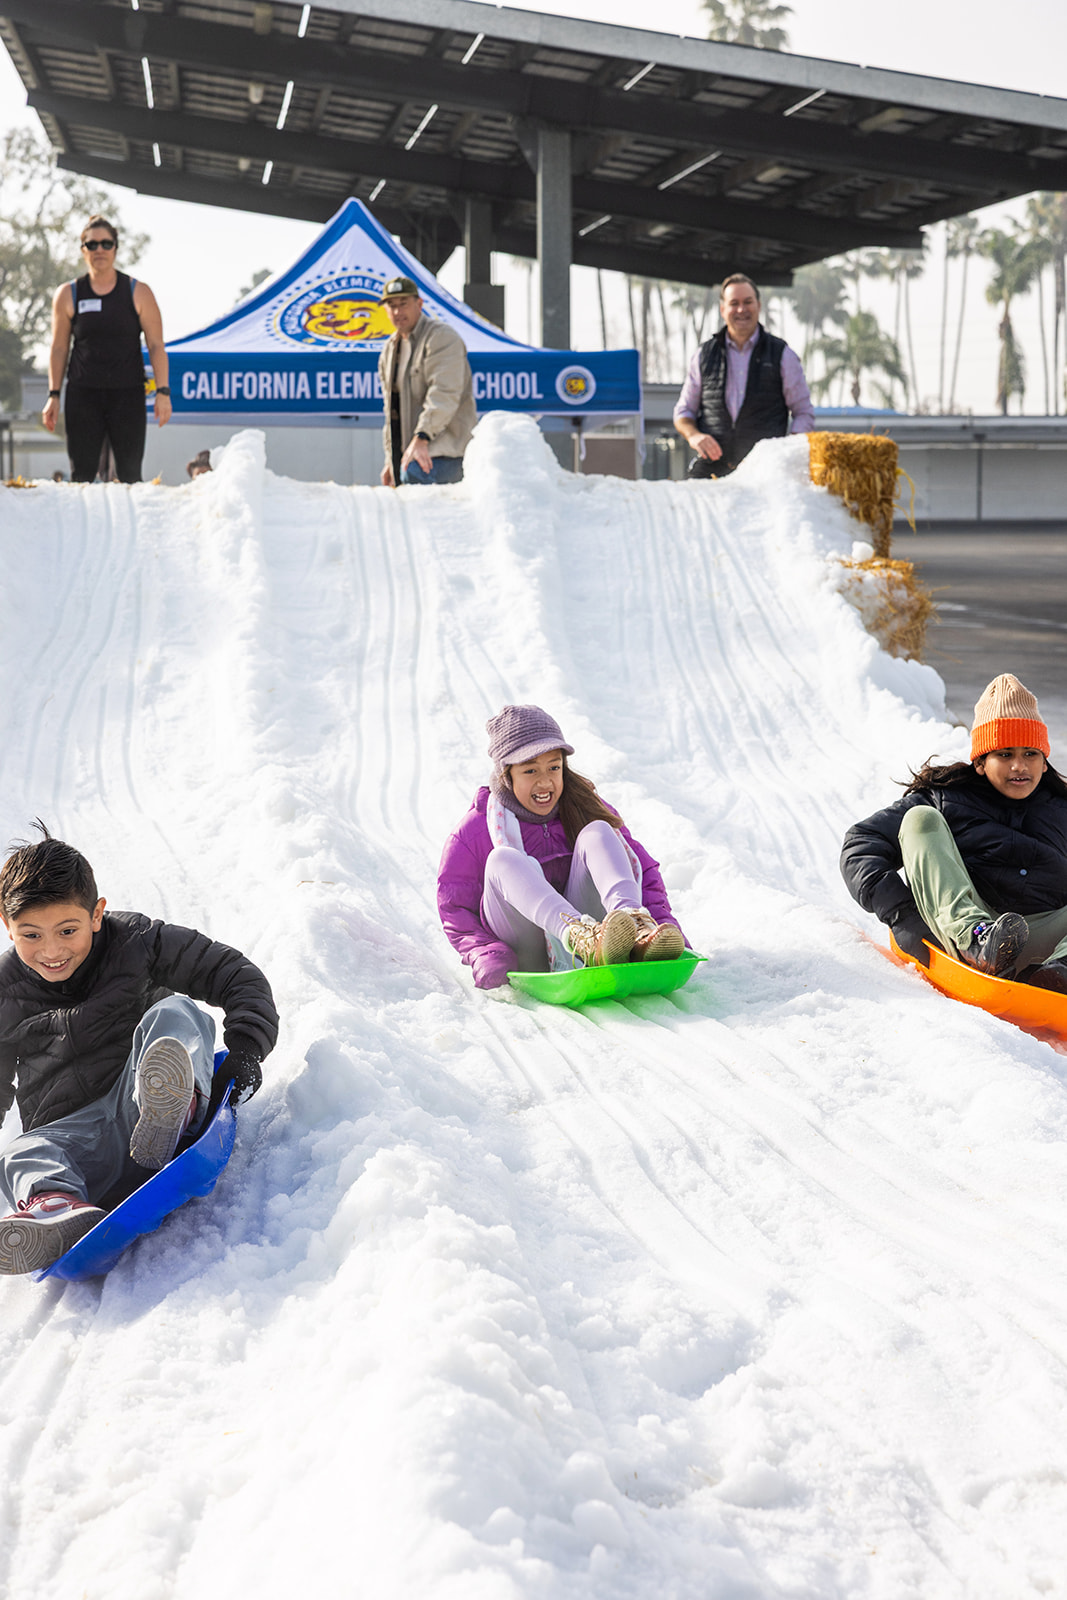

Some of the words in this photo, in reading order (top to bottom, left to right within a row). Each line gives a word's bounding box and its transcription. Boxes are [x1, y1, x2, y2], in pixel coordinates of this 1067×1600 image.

[323, 277, 385, 293] ELEMEN
[181, 371, 311, 400] CALIFORNIA
[315, 371, 384, 400] ELEME
[472, 371, 544, 400] CHOOL
